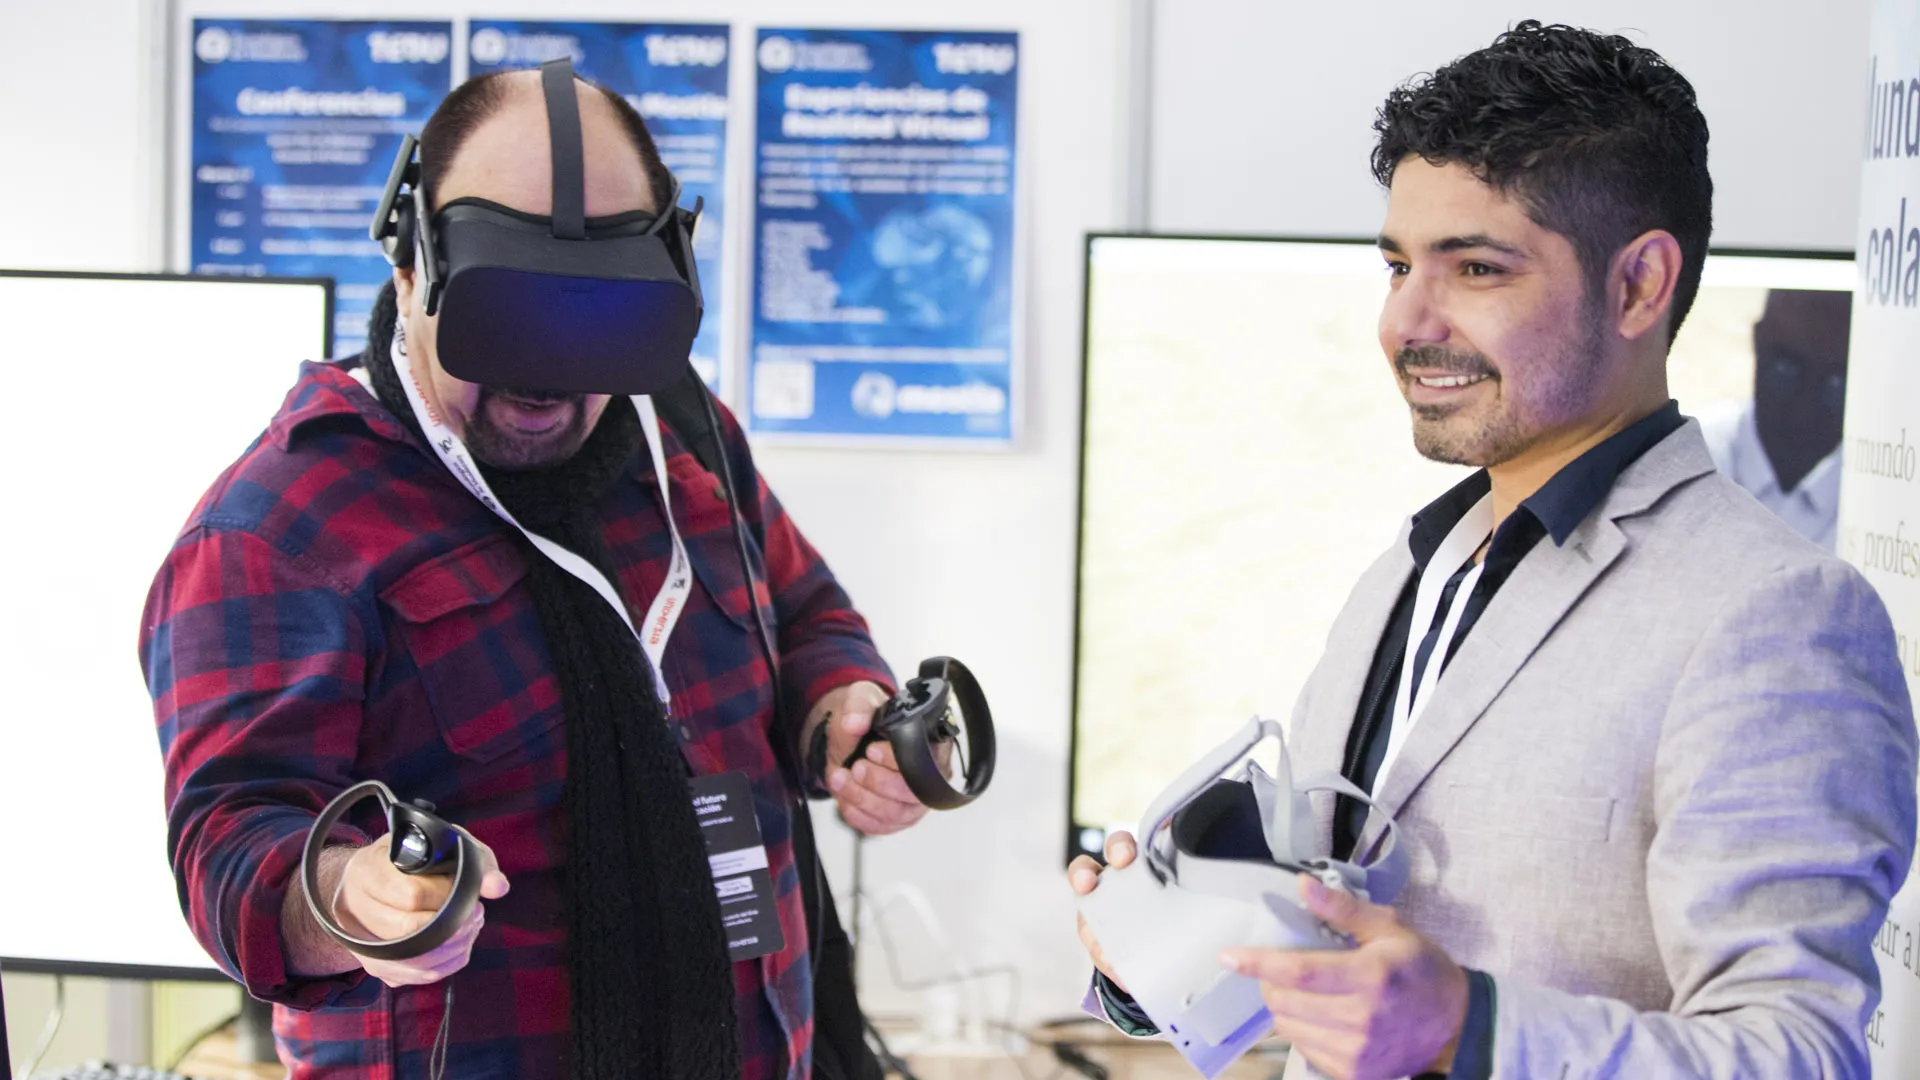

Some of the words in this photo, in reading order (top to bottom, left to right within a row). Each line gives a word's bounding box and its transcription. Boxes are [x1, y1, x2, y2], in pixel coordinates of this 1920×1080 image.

[238, 88, 405, 115] Conferencias
[1855, 428, 1916, 482] mundo
[1866, 1010, 1885, 1048] ar.
